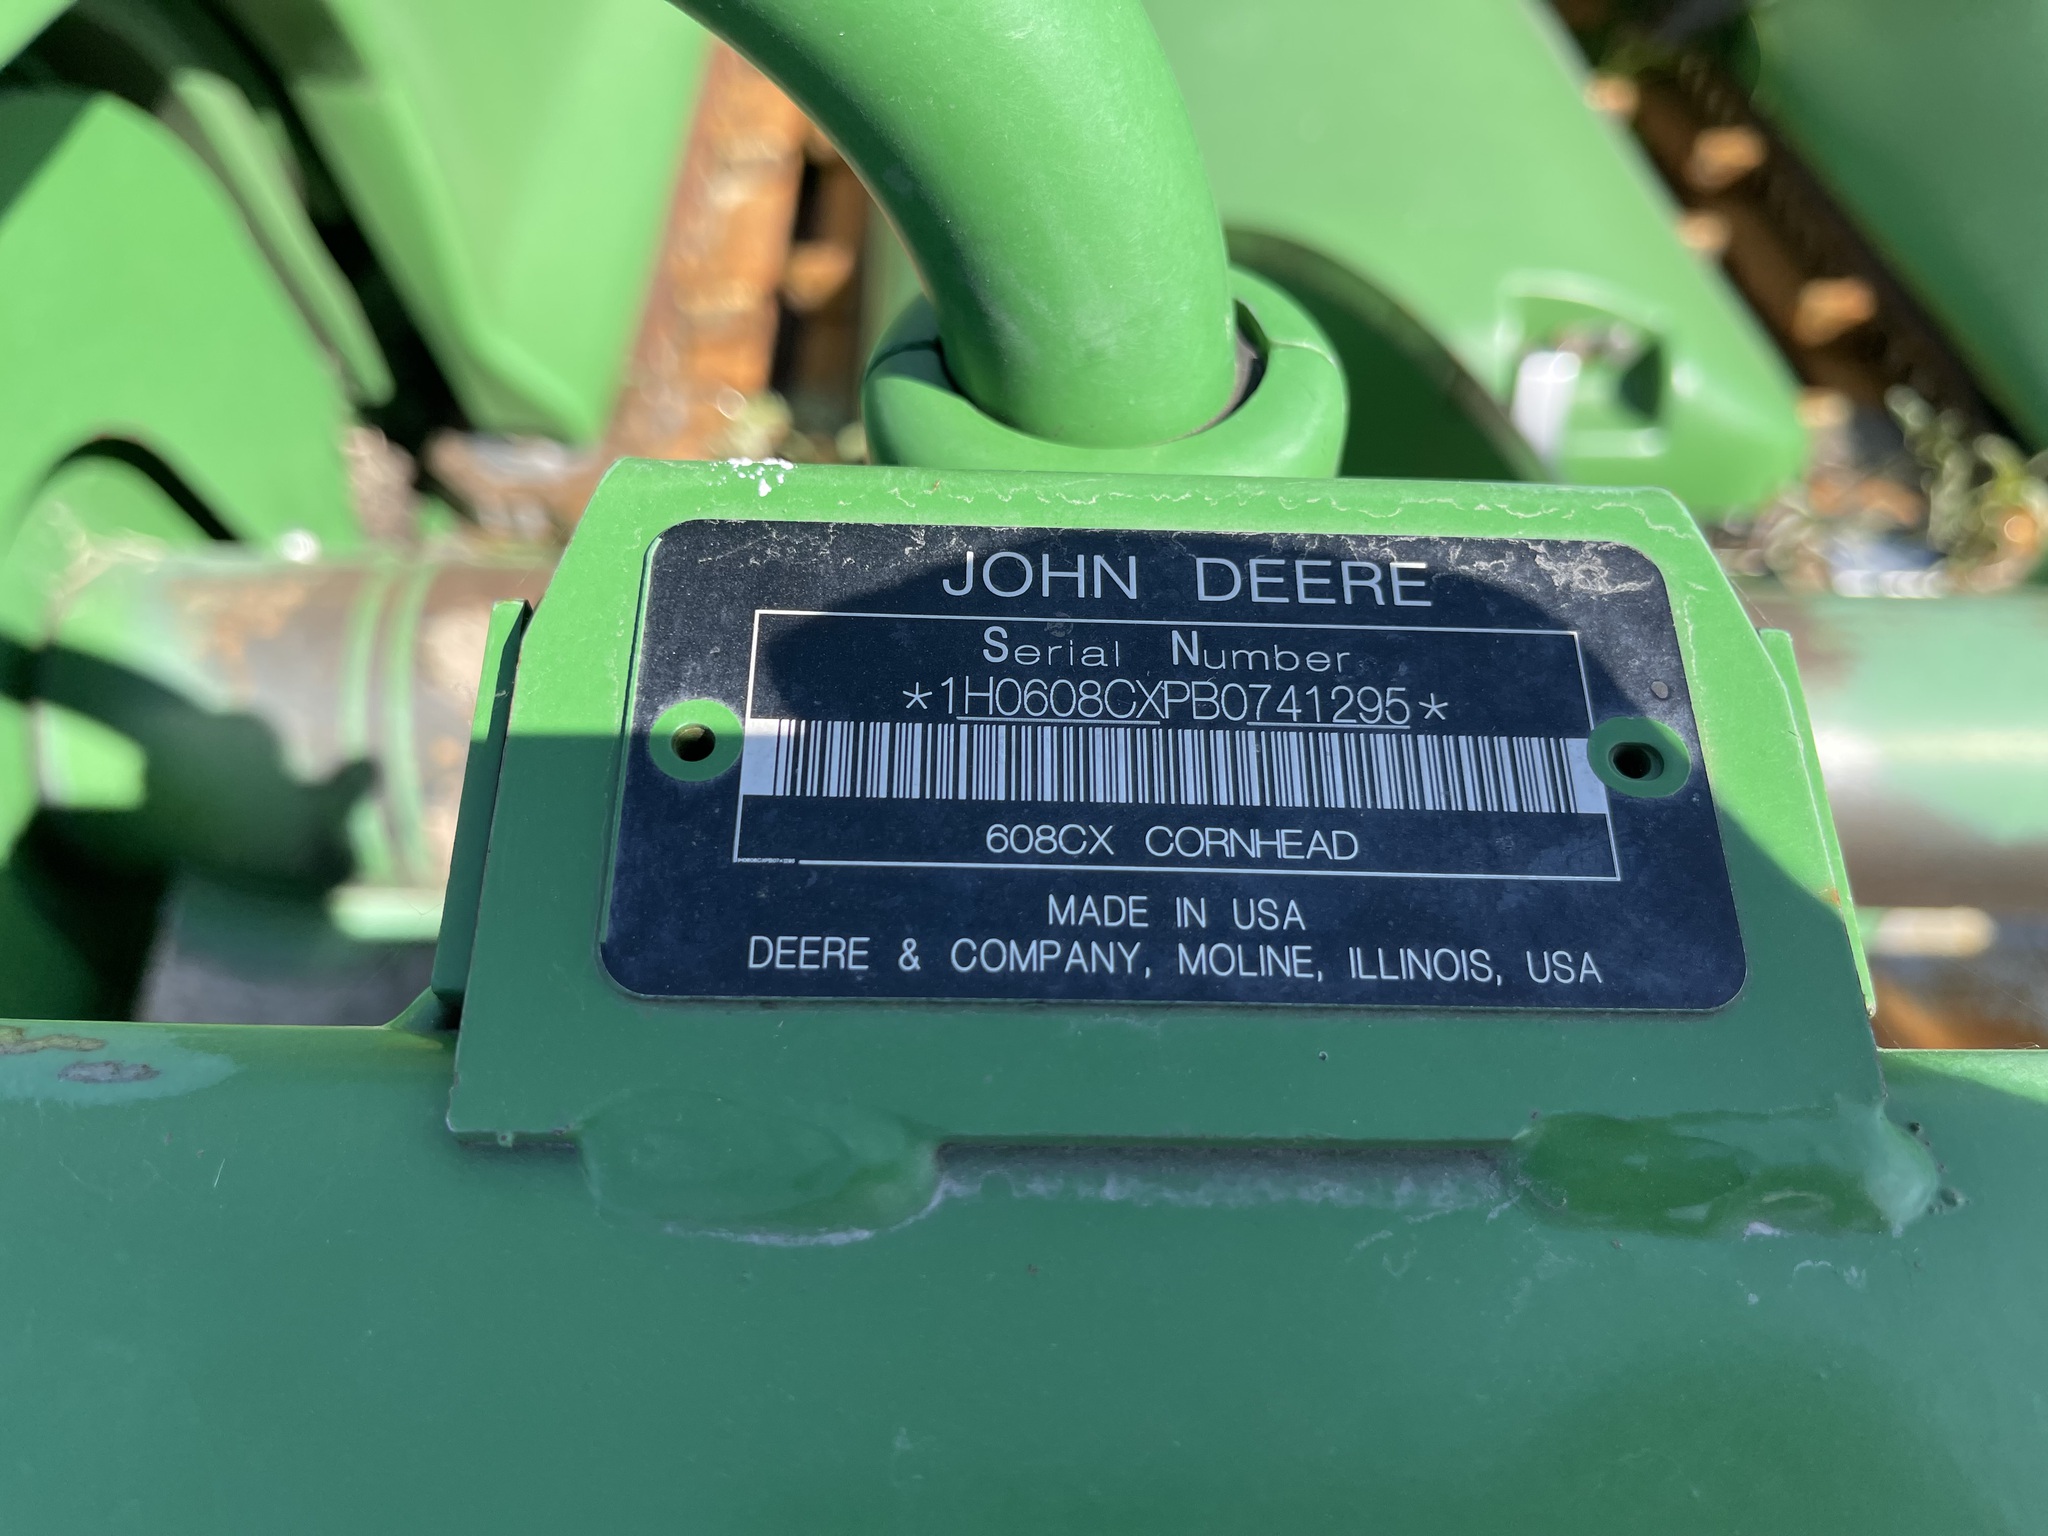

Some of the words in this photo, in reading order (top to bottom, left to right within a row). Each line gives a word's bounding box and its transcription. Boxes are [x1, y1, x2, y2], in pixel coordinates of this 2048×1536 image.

[942, 550, 1138, 600] JOHN
[1195, 556, 1434, 607] DEERE
[982, 625, 1120, 668] Serial
[1171, 629, 1351, 673] Number
[985, 823, 1115, 856] 608CX
[1145, 826, 1359, 861] CORNHEAD
[1048, 893, 1149, 928] MADE
[1175, 896, 1207, 929] IN
[1232, 897, 1306, 931] USA
[748, 935, 871, 971] DEERE
[898, 937, 922, 972] &
[950, 938, 1152, 979] COMPANY,
[1178, 942, 1324, 983] MOLINE,
[1348, 946, 1503, 987] ILLINOIS,
[1525, 950, 1603, 984] USA
